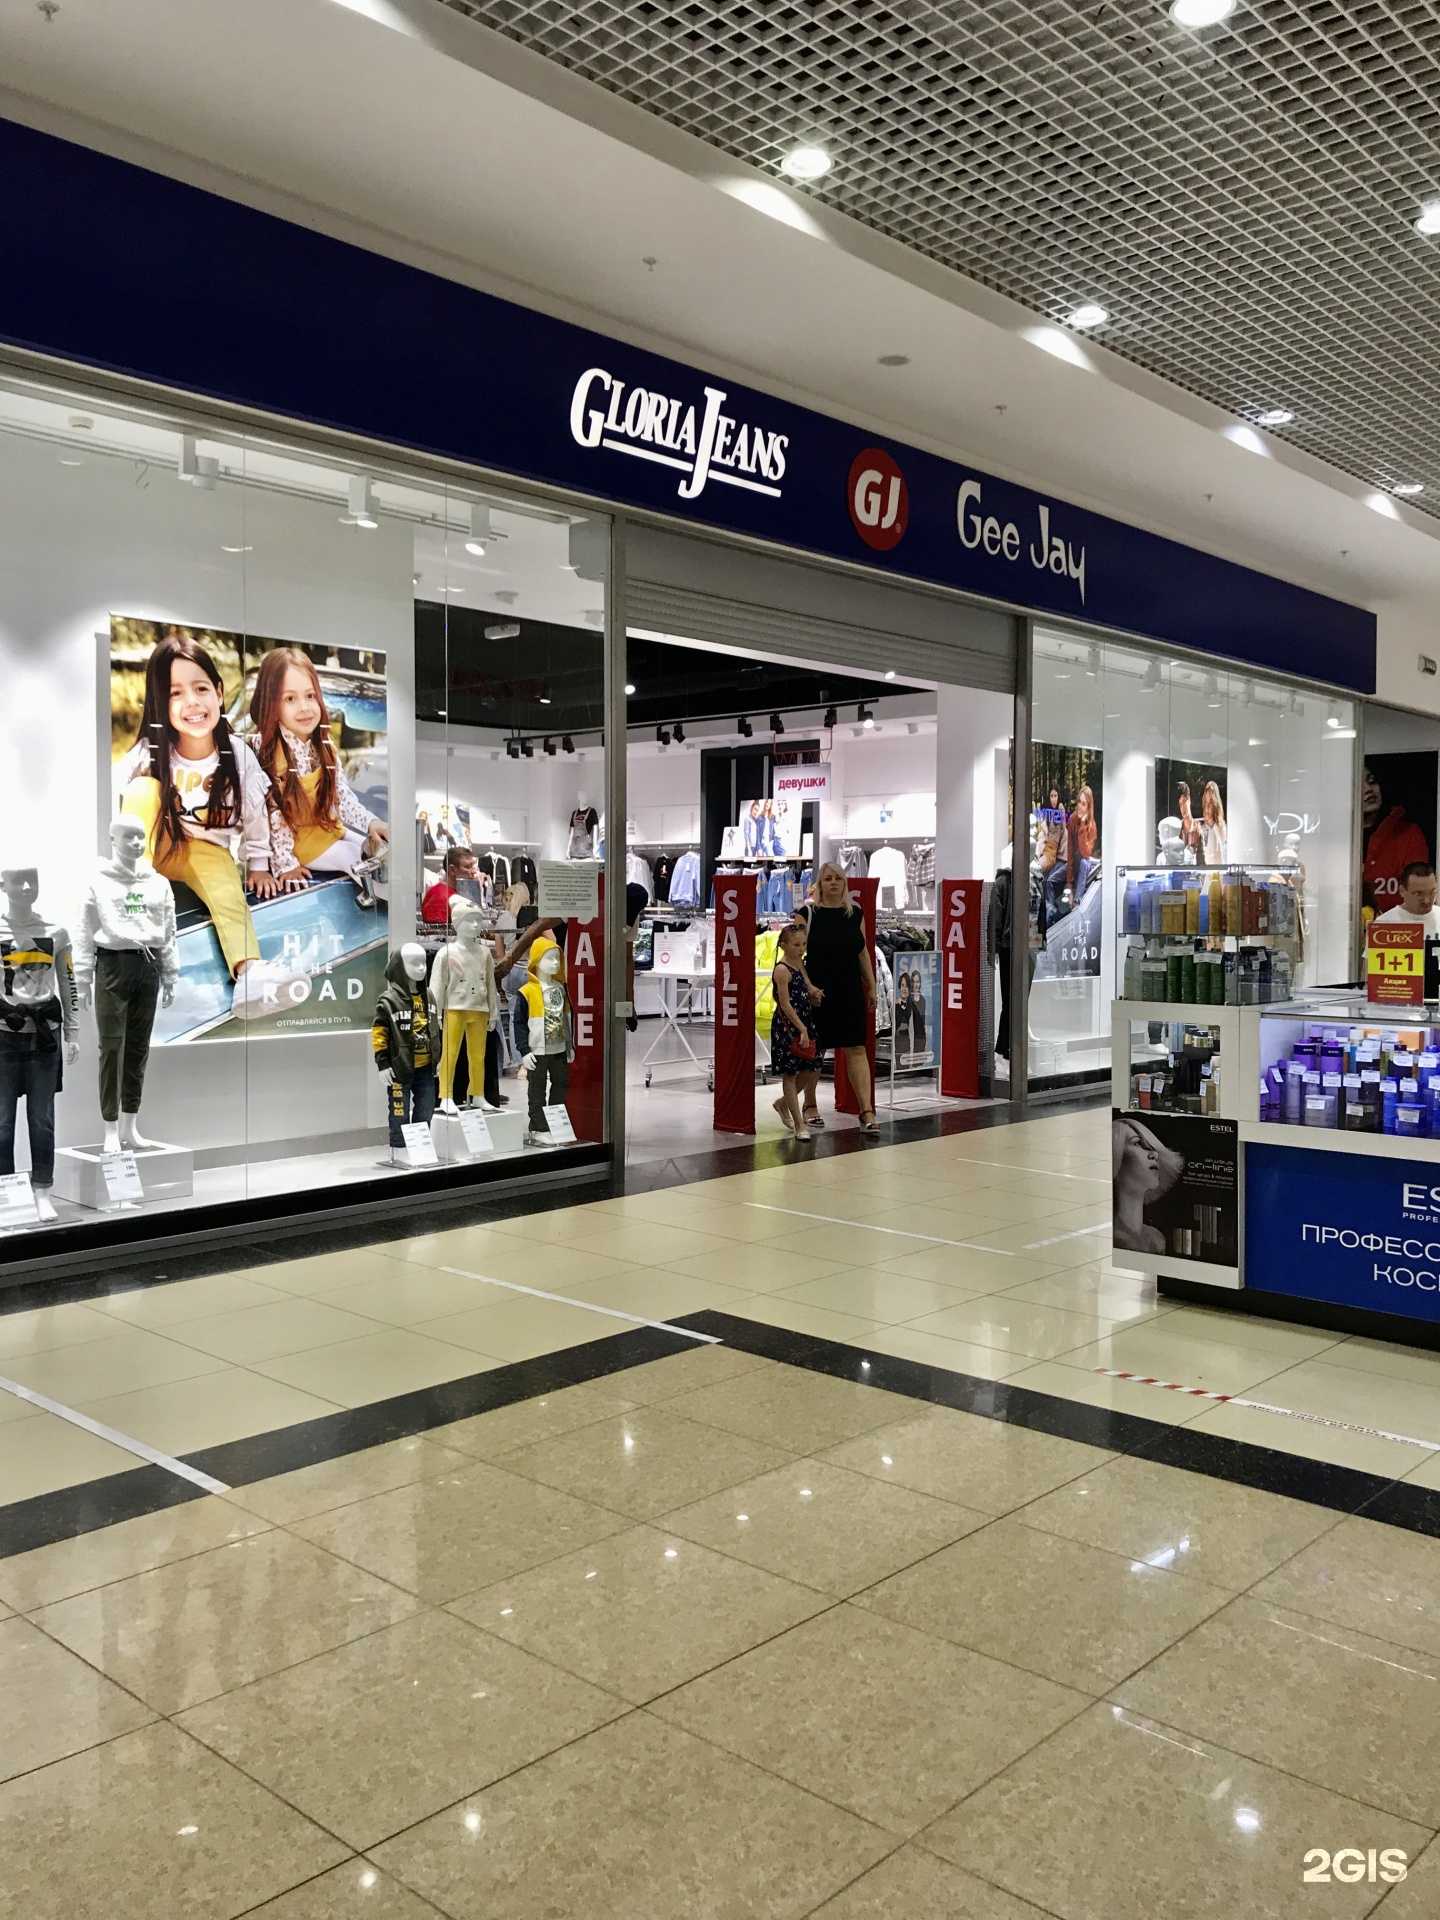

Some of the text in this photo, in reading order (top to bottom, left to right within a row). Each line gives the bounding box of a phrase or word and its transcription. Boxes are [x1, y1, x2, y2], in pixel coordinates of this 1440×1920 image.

[570, 368, 789, 498] GLORIA JEANS
[854, 469, 901, 529] GJ
[957, 480, 1085, 607] Gee Jay
[778, 777, 826, 791] девушки
[283, 934, 345, 956] HIT
[721, 889, 741, 1026] SALE
[946, 889, 966, 1010] SALE
[1062, 946, 1098, 960] ROAD
[1376, 952, 1414, 972] 1+1
[263, 978, 364, 1004] ROAD
[574, 917, 596, 1046] ALE
[1210, 1124, 1234, 1133] ESTEL
[1373, 1263, 1440, 1292] КОС
